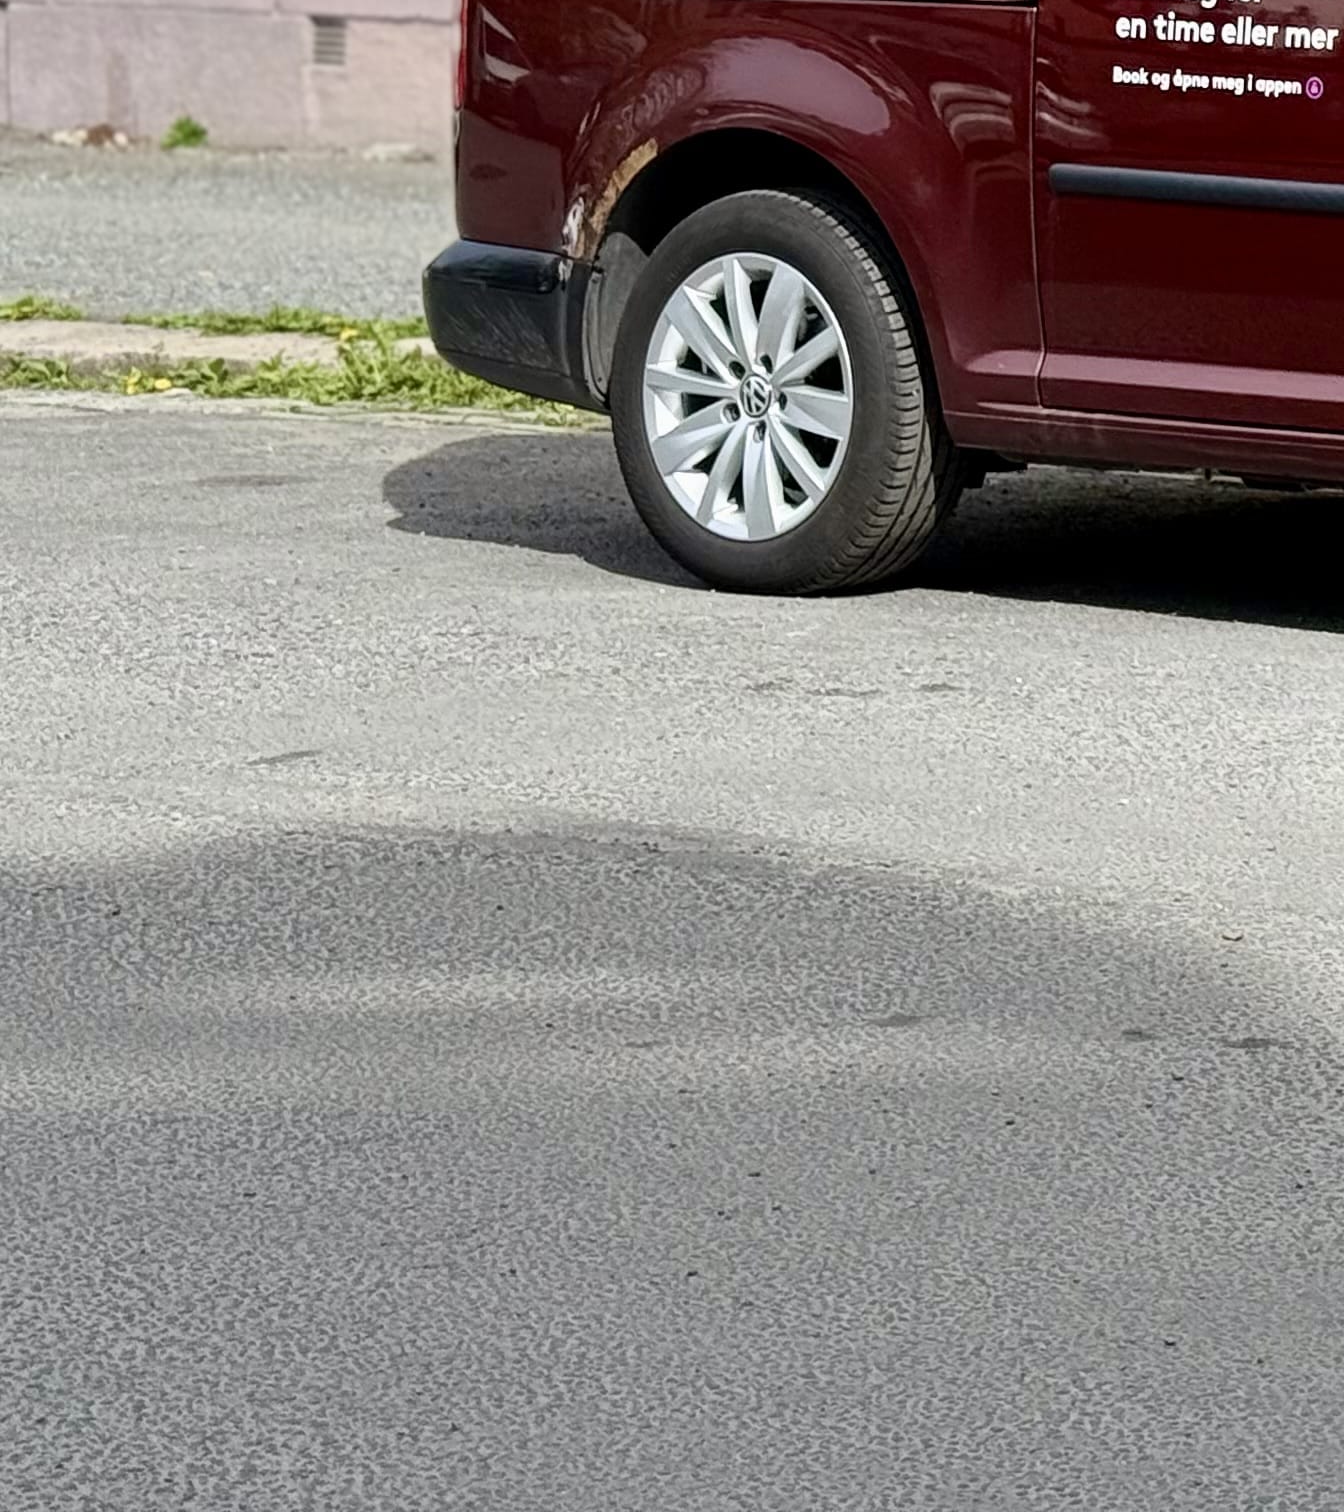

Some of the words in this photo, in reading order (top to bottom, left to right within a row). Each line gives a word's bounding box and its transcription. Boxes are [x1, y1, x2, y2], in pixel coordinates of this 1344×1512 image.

[1115, 16, 1147, 39] en
[1153, 11, 1215, 43] time
[1220, 16, 1279, 47] eller
[1284, 26, 1339, 51] mer
[1112, 65, 1149, 85] Book
[1151, 71, 1170, 91] og
[1172, 68, 1209, 92] åpne
[1212, 75, 1244, 95] meg
[1247, 73, 1254, 92] i
[1255, 79, 1302, 98] appen
